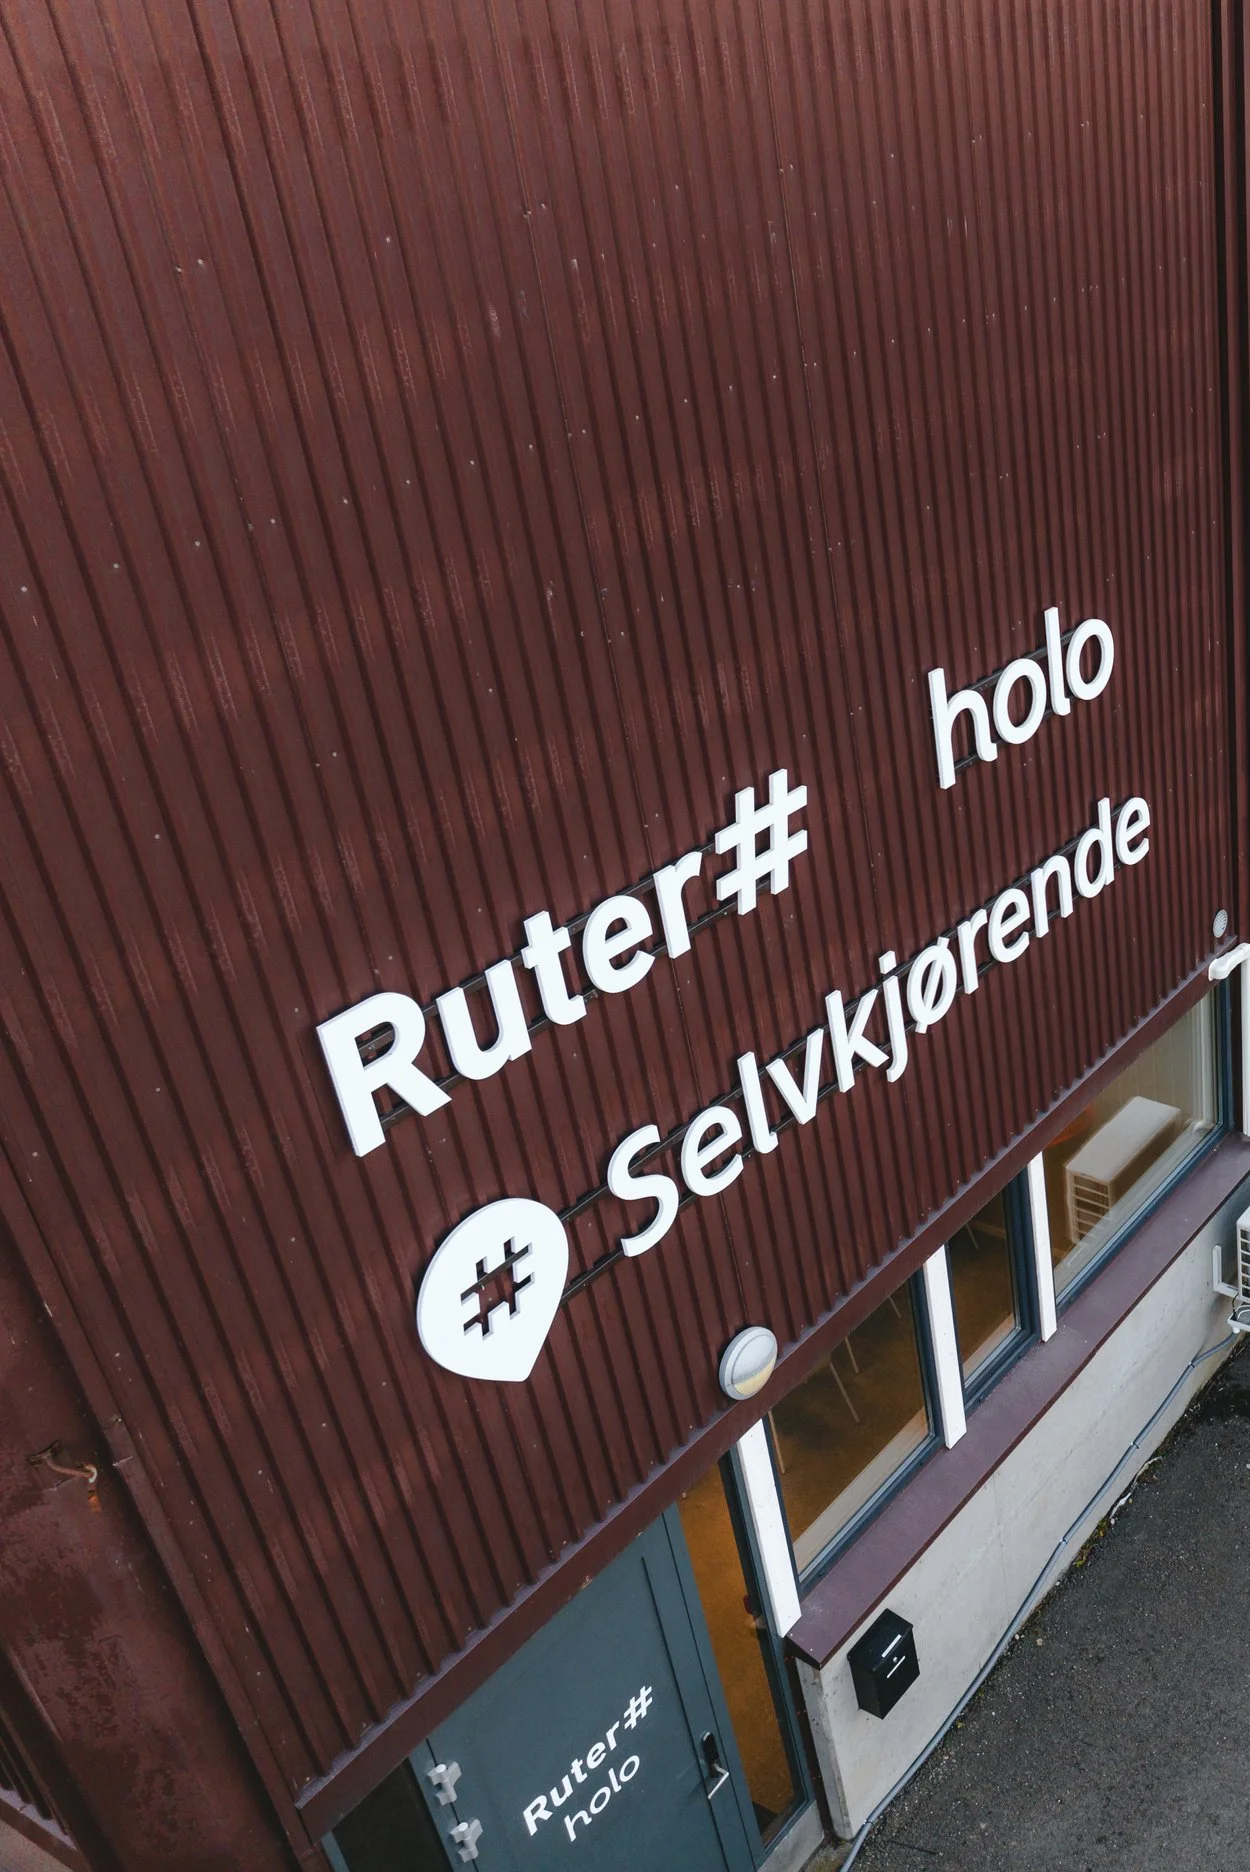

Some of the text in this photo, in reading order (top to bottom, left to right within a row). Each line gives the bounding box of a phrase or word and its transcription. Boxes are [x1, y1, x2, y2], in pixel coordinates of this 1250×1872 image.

[927, 606, 1115, 790] holo
[315, 768, 809, 1158] Ruter#
[606, 796, 1151, 1259] Selvkjørende
[521, 1685, 653, 1837] Ruter#
[563, 1753, 641, 1843] holo
